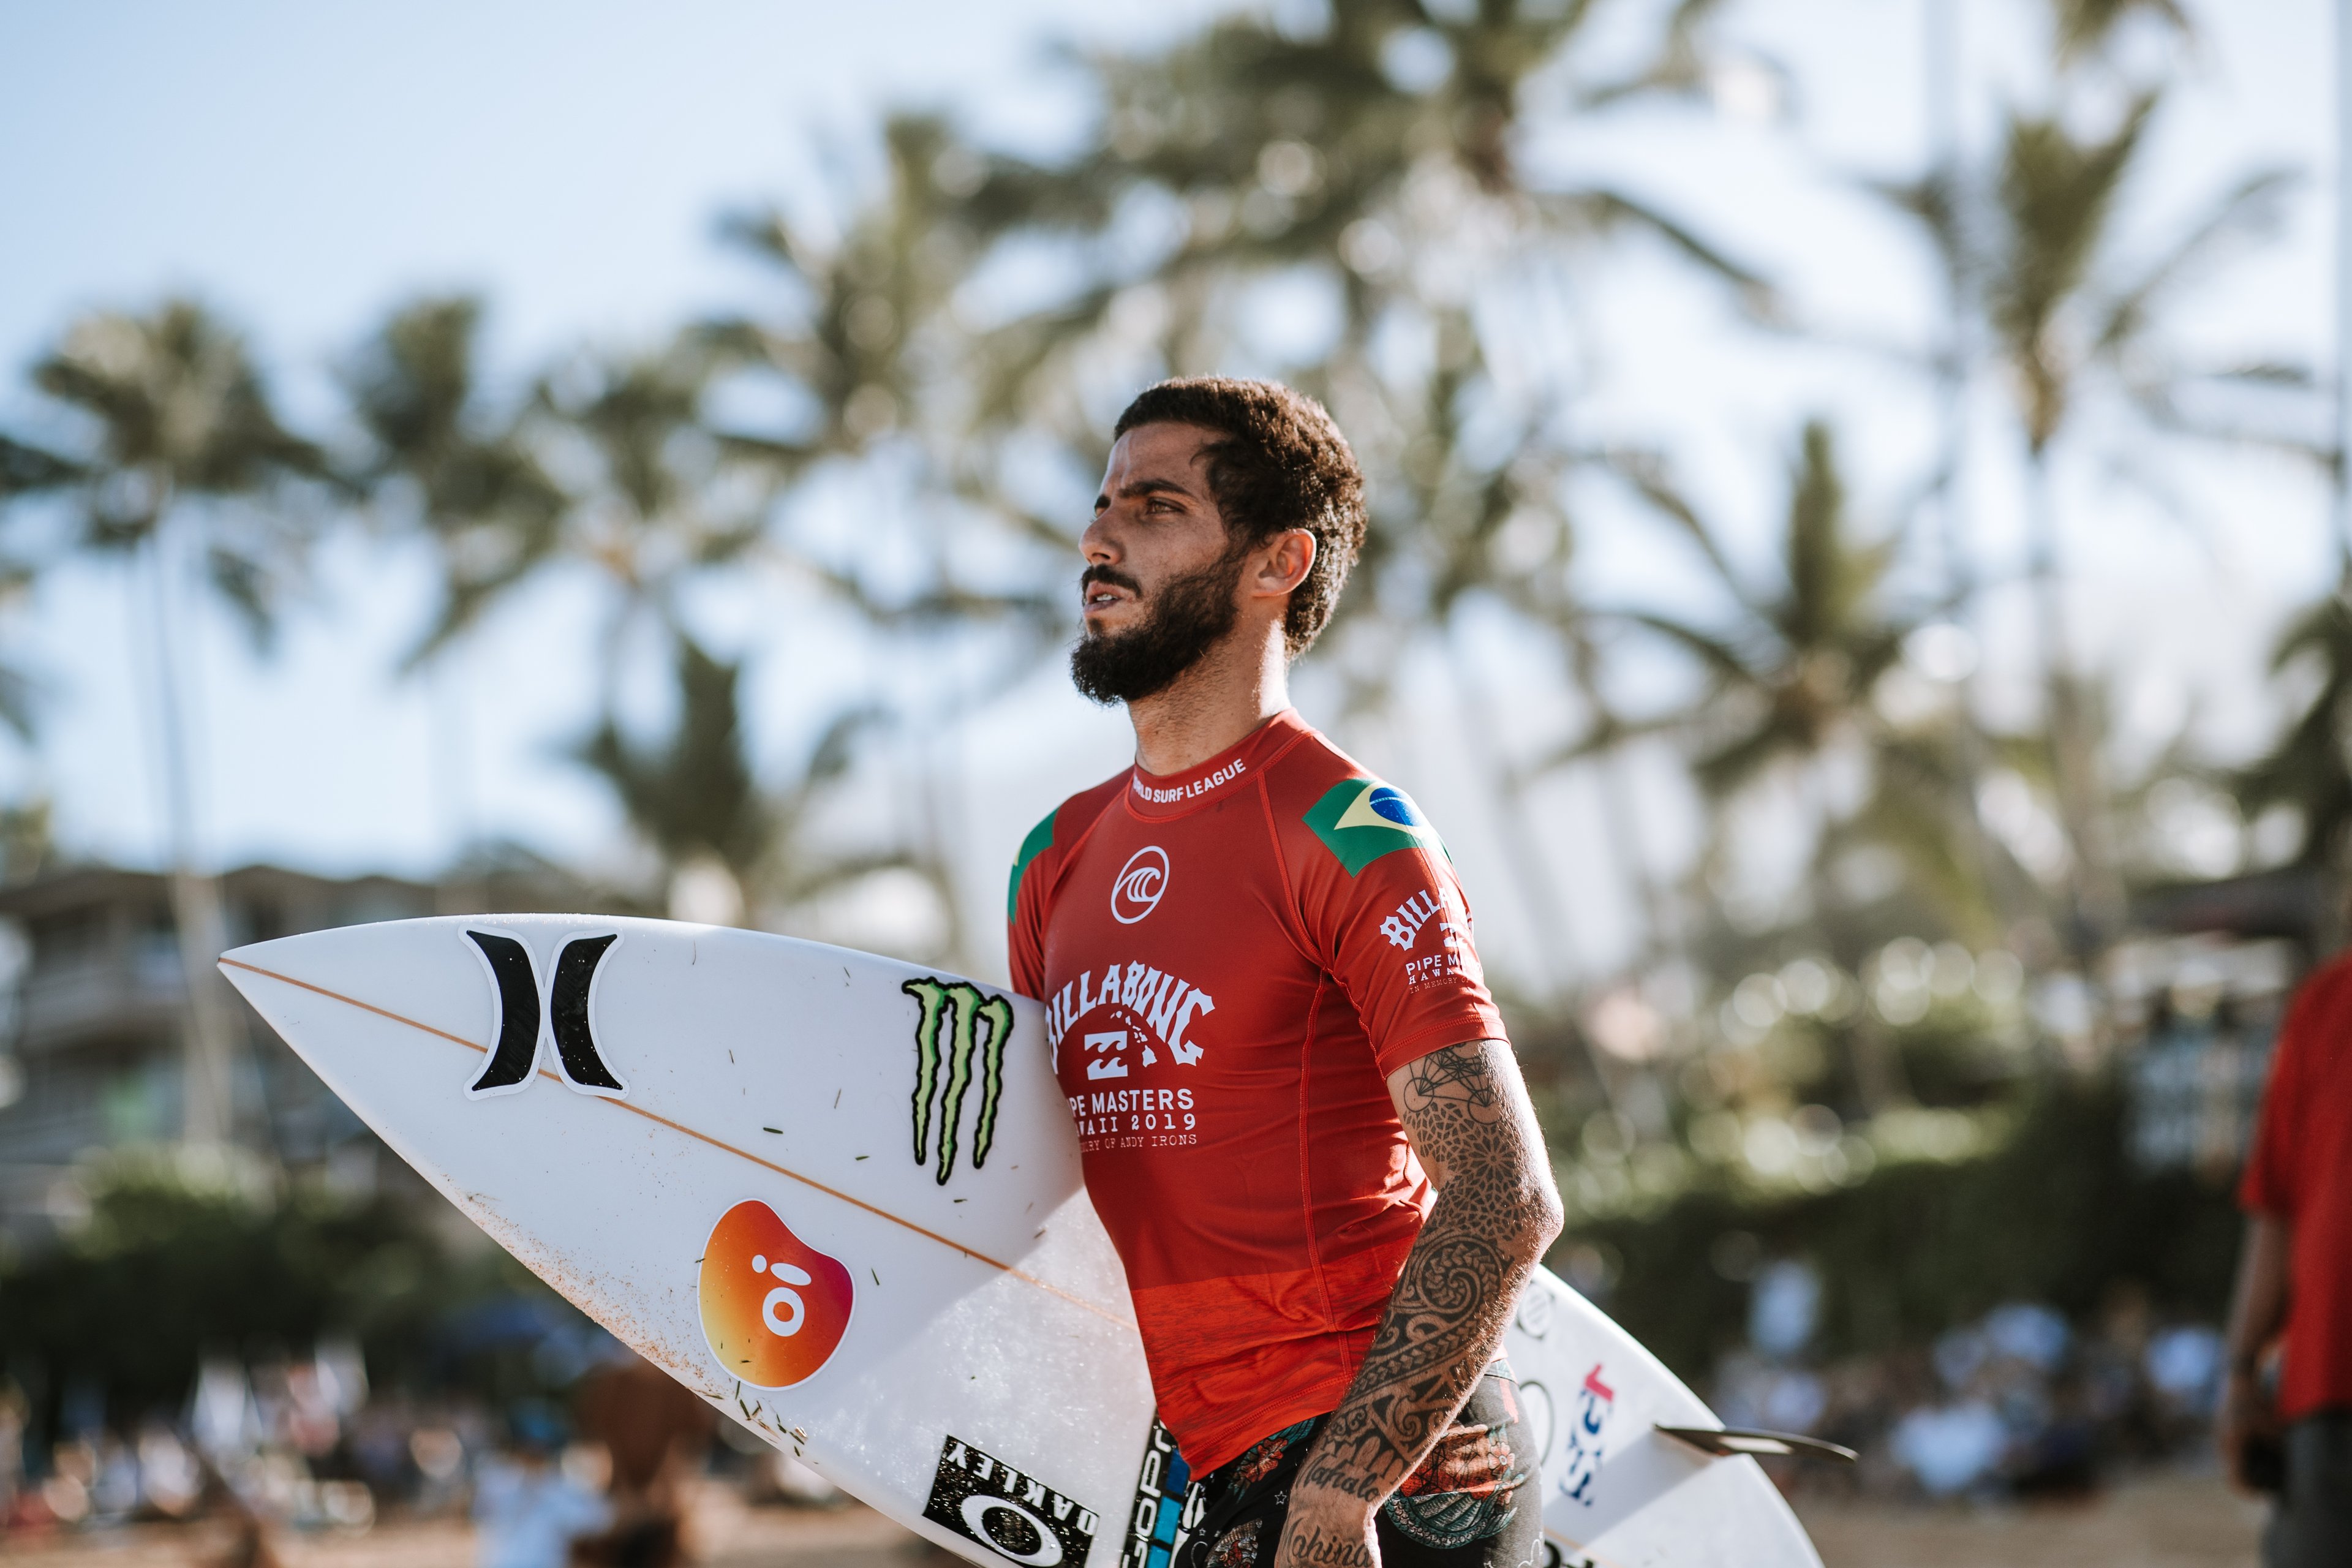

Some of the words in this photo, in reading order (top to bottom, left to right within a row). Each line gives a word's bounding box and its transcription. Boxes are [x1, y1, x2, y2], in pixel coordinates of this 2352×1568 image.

[1153, 786, 1183, 803] SURF
[1186, 758, 1246, 798] LEAGUE
[1405, 954, 1442, 976] PIPE
[1408, 968, 1455, 985] HAWA
[1409, 986, 1420, 994] IN
[1424, 977, 1457, 989] MEMORY
[1045, 960, 1216, 1074] BILLABONG
[1068, 1095, 1086, 1118] PE
[1091, 1088, 1194, 1115] MASTERS
[1131, 1113, 1196, 1131] 2019
[1104, 1138, 1116, 1149] OF
[1120, 1136, 1144, 1147] ANDY
[1152, 1134, 1197, 1147] IRONS
[946, 1442, 1099, 1536] OAKLEY
[1122, 1419, 1172, 1568] GoPr
